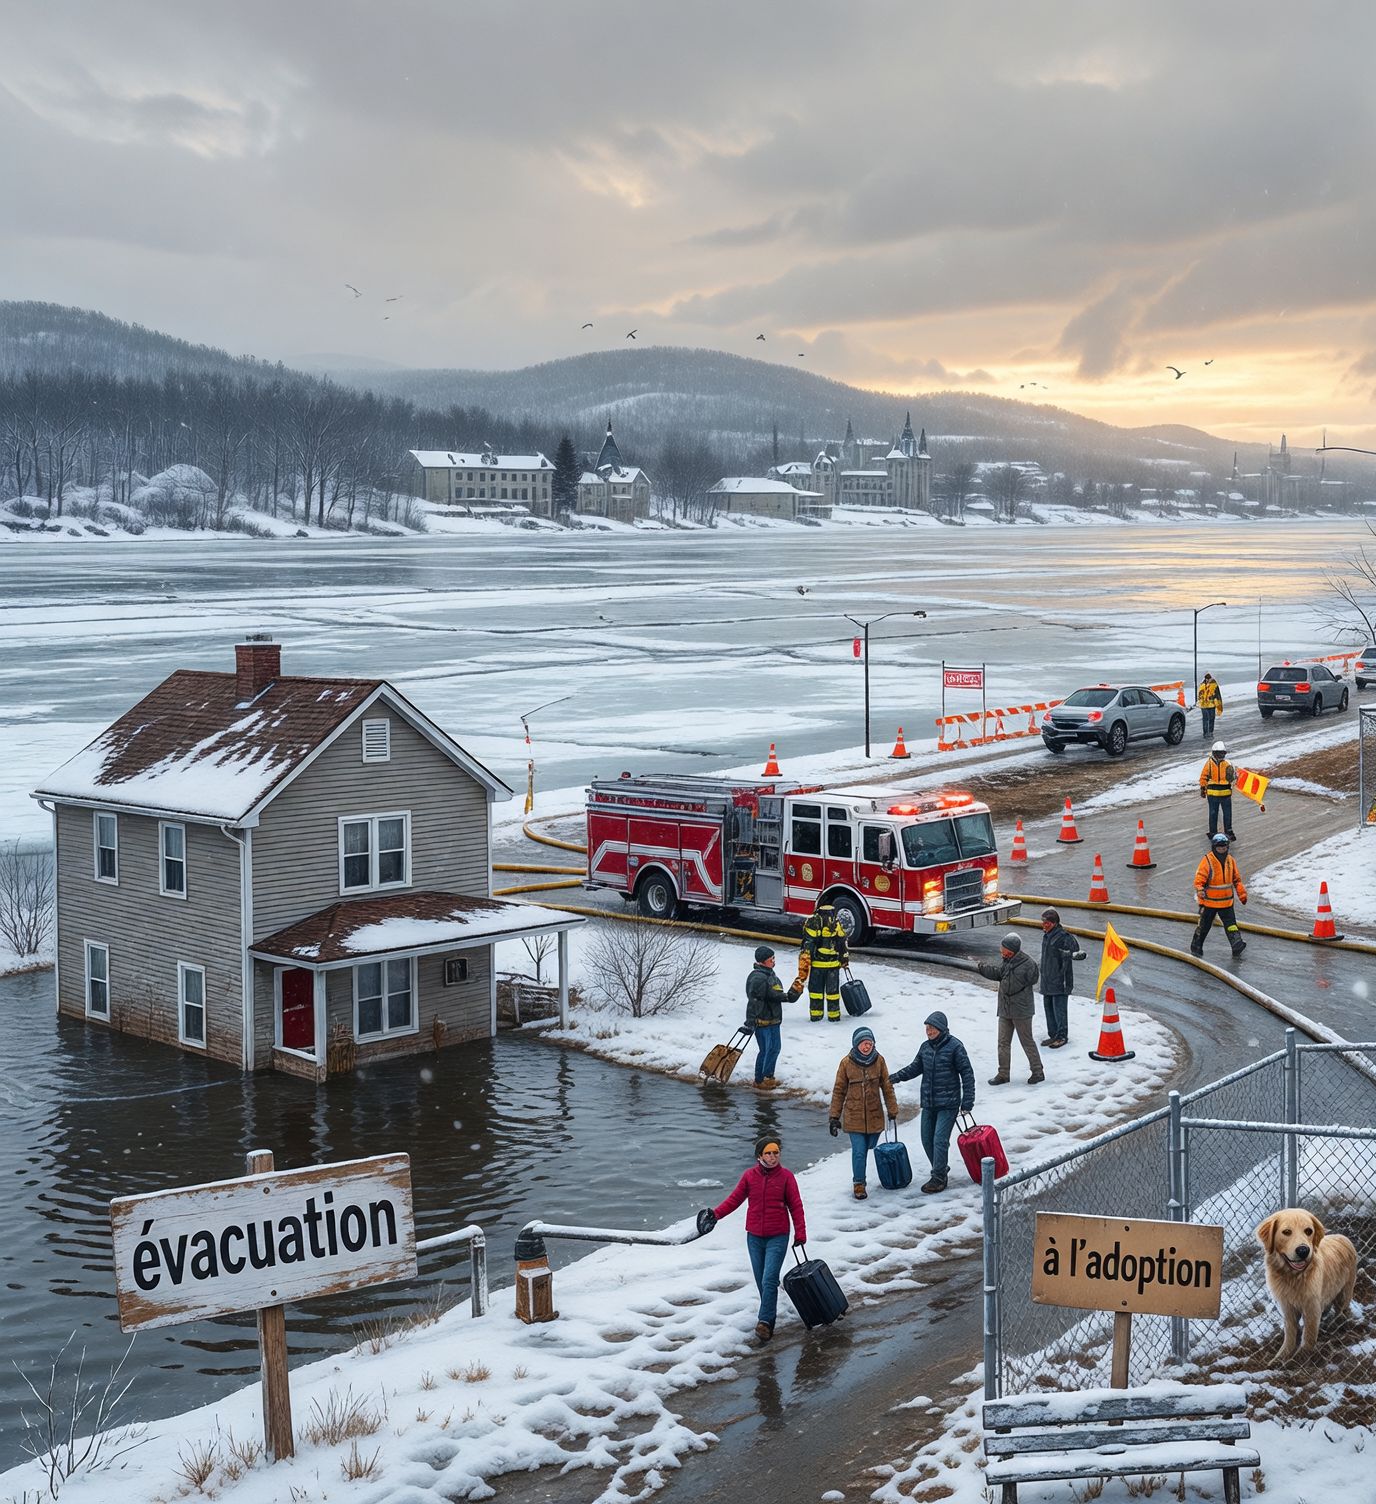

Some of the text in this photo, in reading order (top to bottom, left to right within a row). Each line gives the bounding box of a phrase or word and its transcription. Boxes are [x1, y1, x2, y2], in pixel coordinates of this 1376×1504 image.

[132, 1190, 398, 1291] évacuation
[1043, 1236, 1212, 1295] à l'adoption
